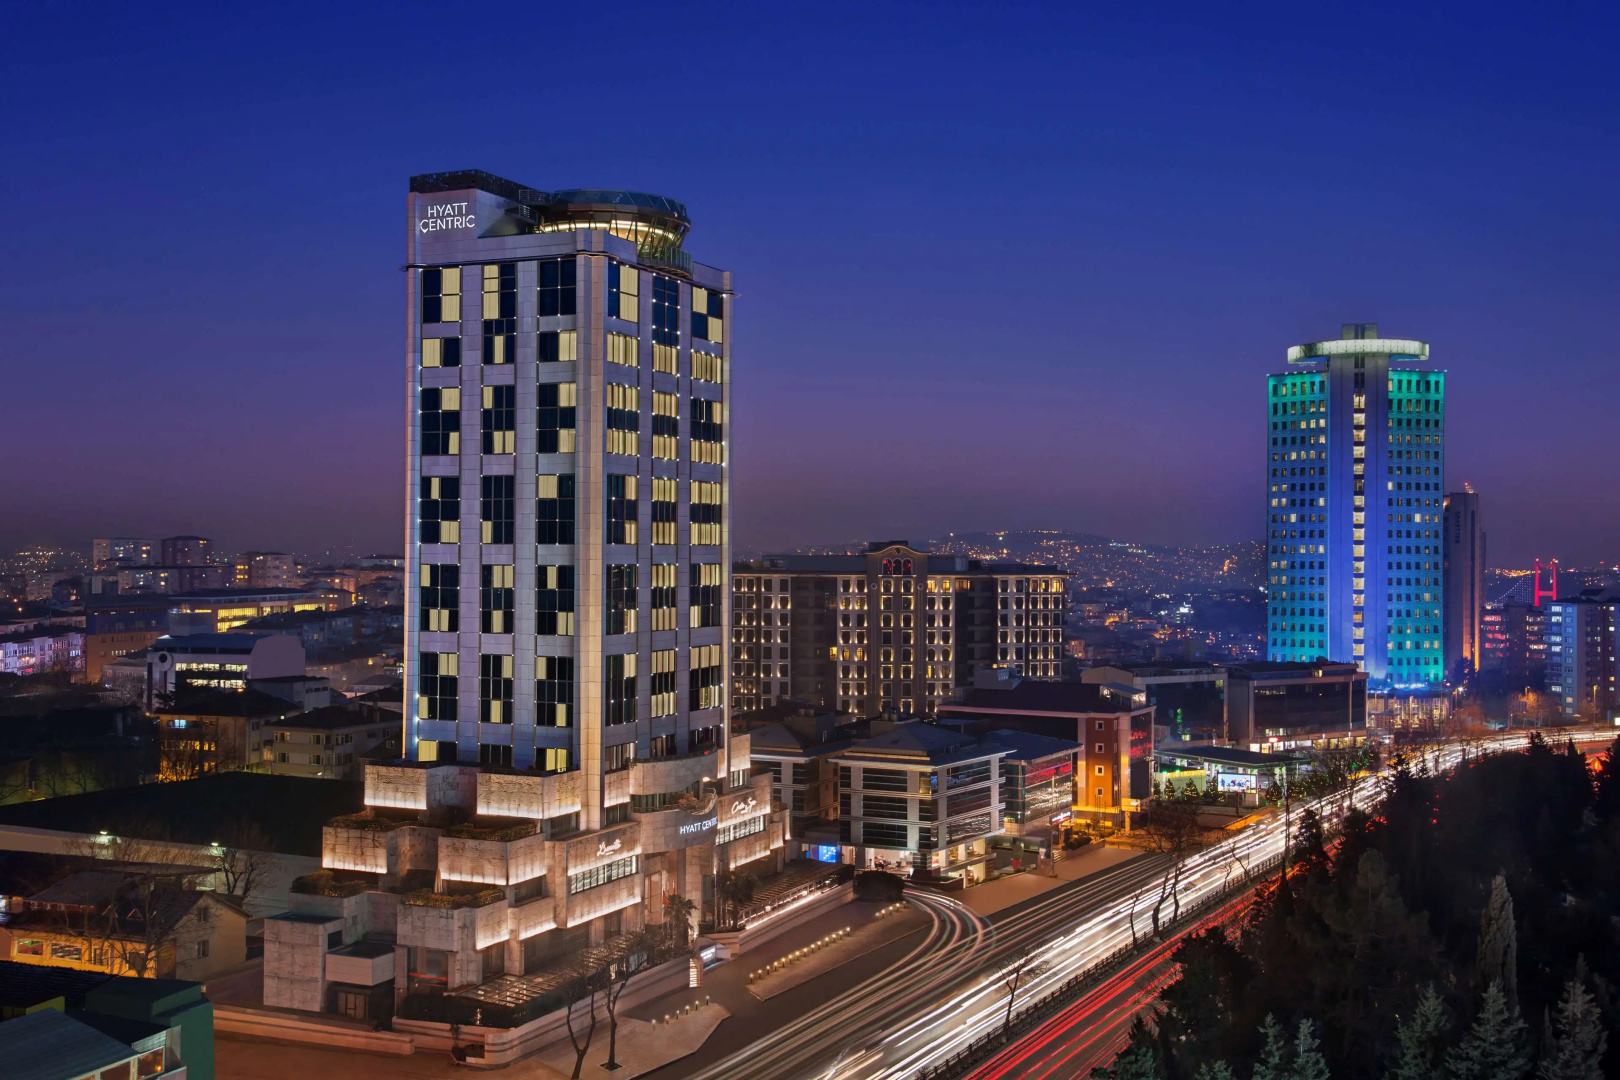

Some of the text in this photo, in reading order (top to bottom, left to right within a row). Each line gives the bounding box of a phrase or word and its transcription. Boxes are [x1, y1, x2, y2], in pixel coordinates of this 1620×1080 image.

[428, 202, 468, 218] HYATT
[420, 215, 475, 233] CENTRIC
[680, 822, 701, 834] HYATT
